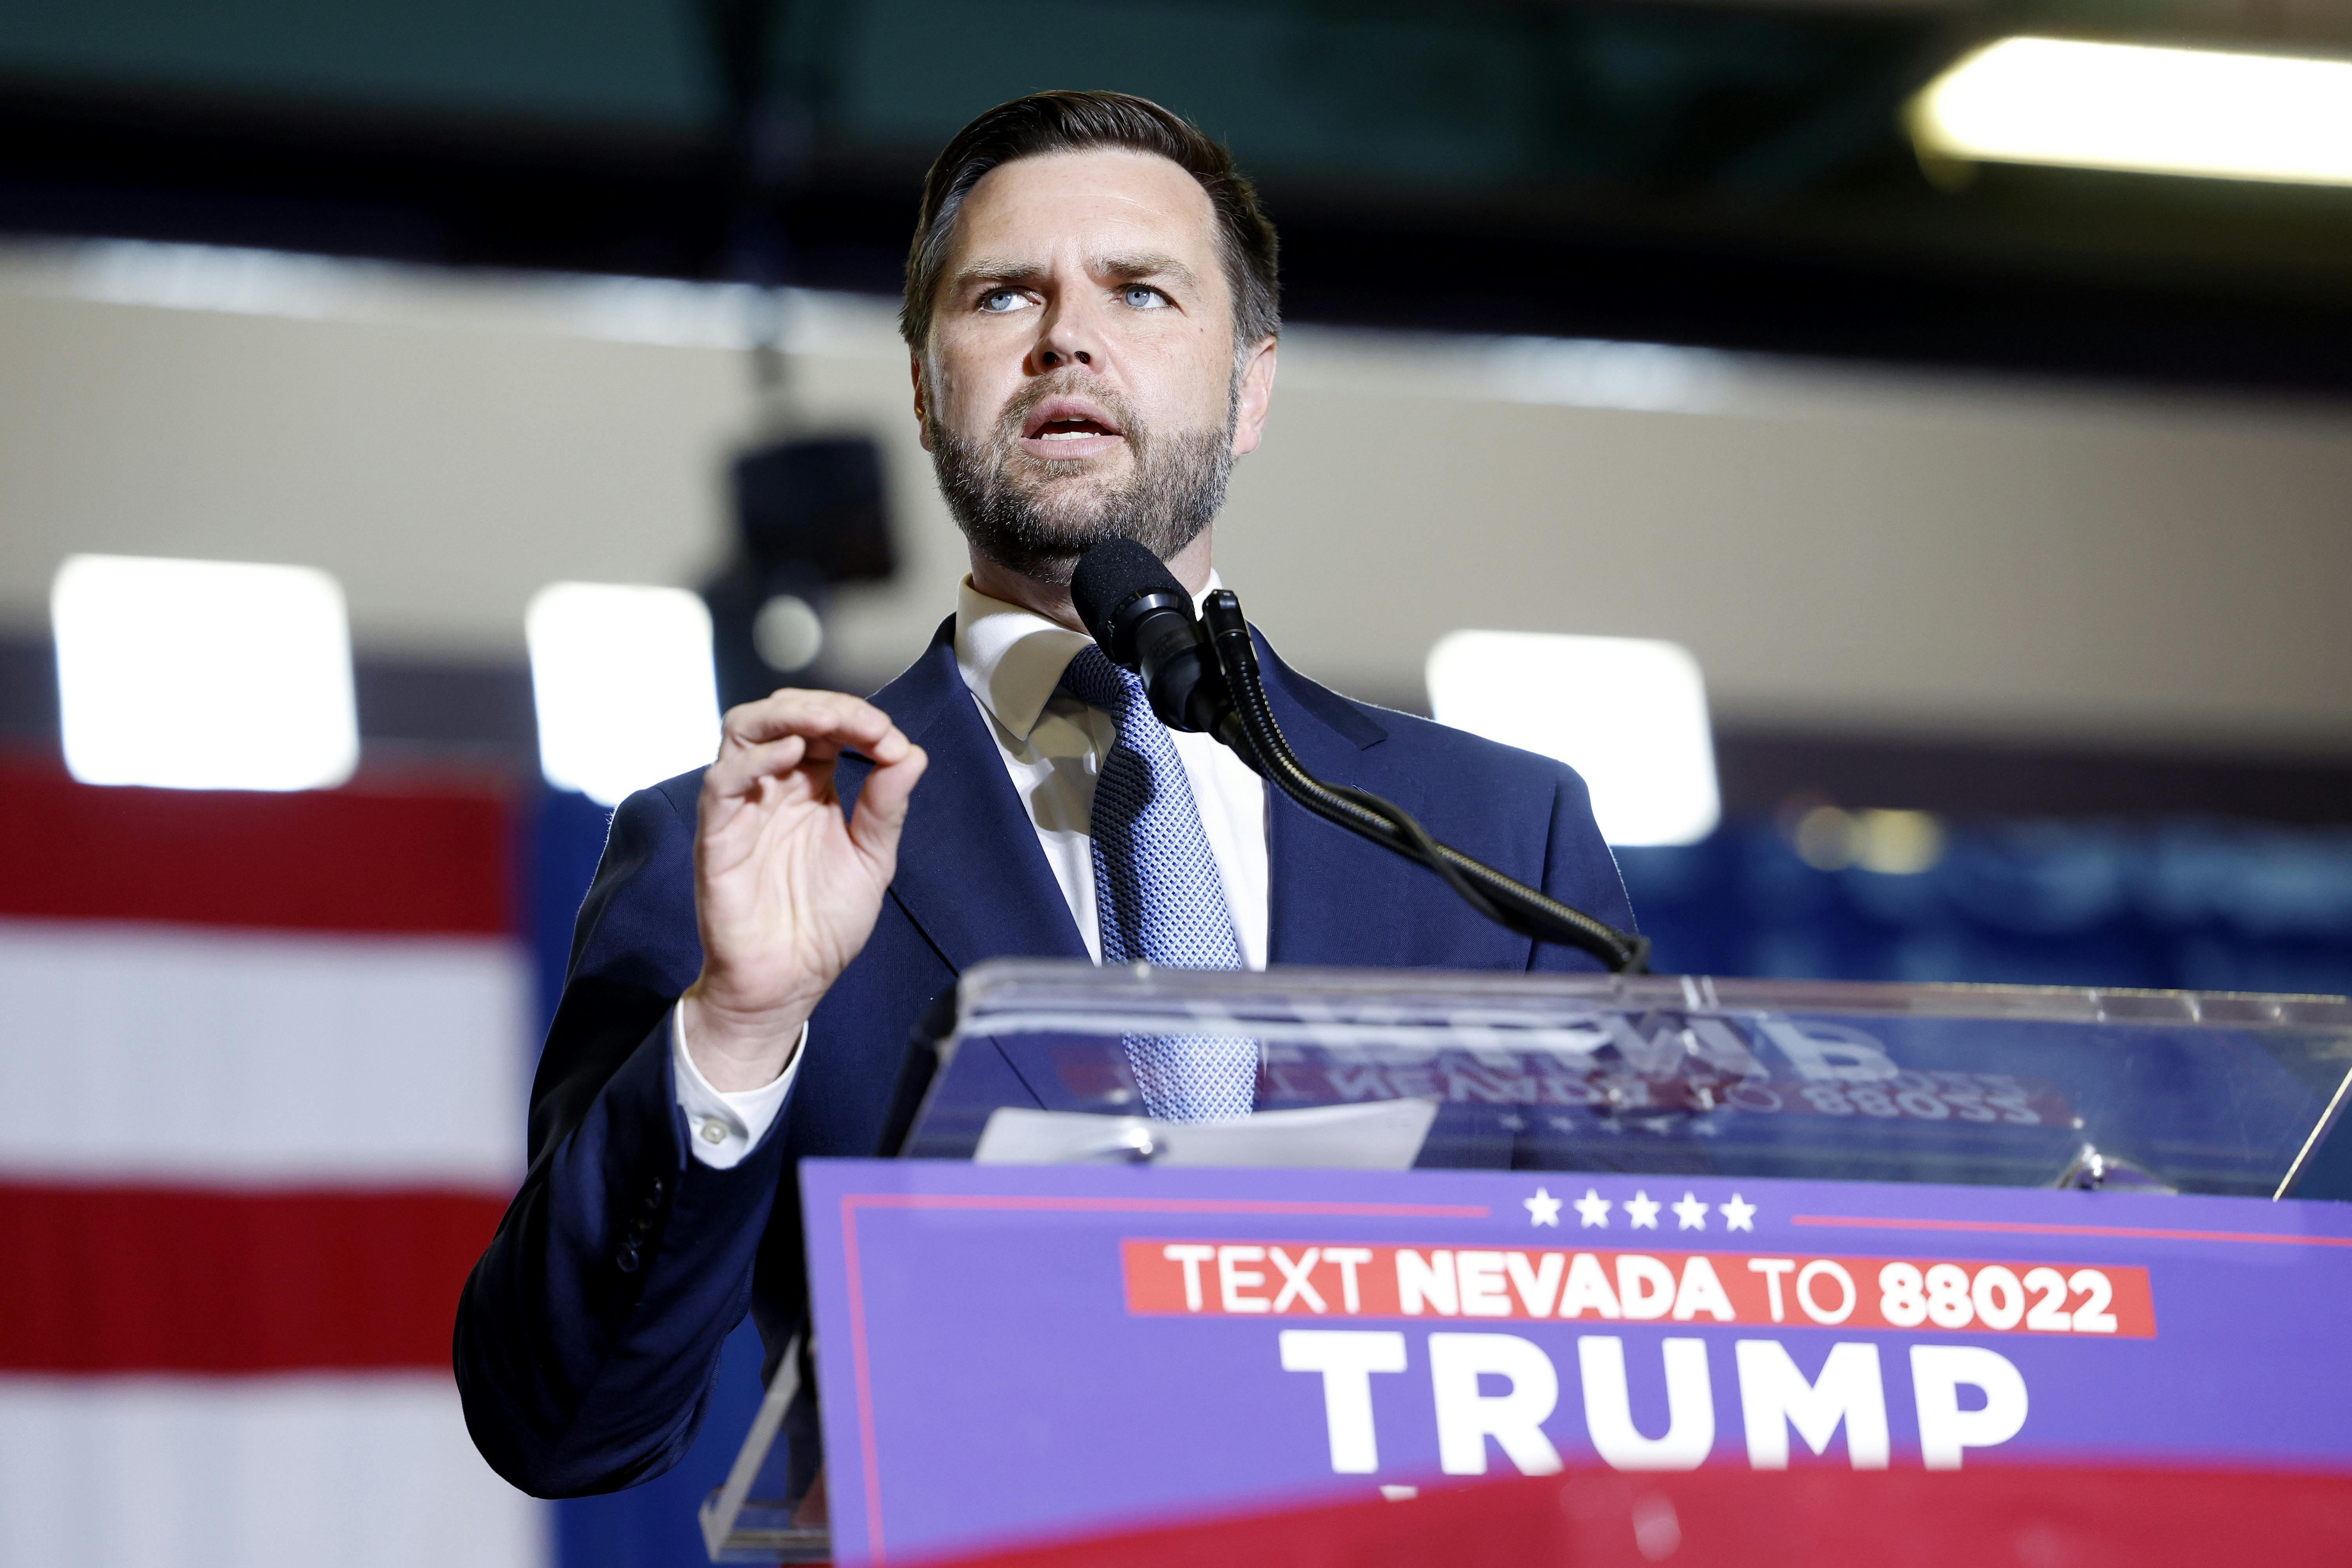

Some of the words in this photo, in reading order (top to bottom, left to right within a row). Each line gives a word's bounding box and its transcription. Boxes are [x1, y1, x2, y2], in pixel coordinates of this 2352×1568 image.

[1163, 1244, 1373, 1314] TEXT
[1394, 1249, 1736, 1322] NEVADA
[1747, 1258, 1857, 1325] TO
[1878, 1261, 2117, 1333] 88022
[1278, 1329, 2029, 1477] TRUMP
